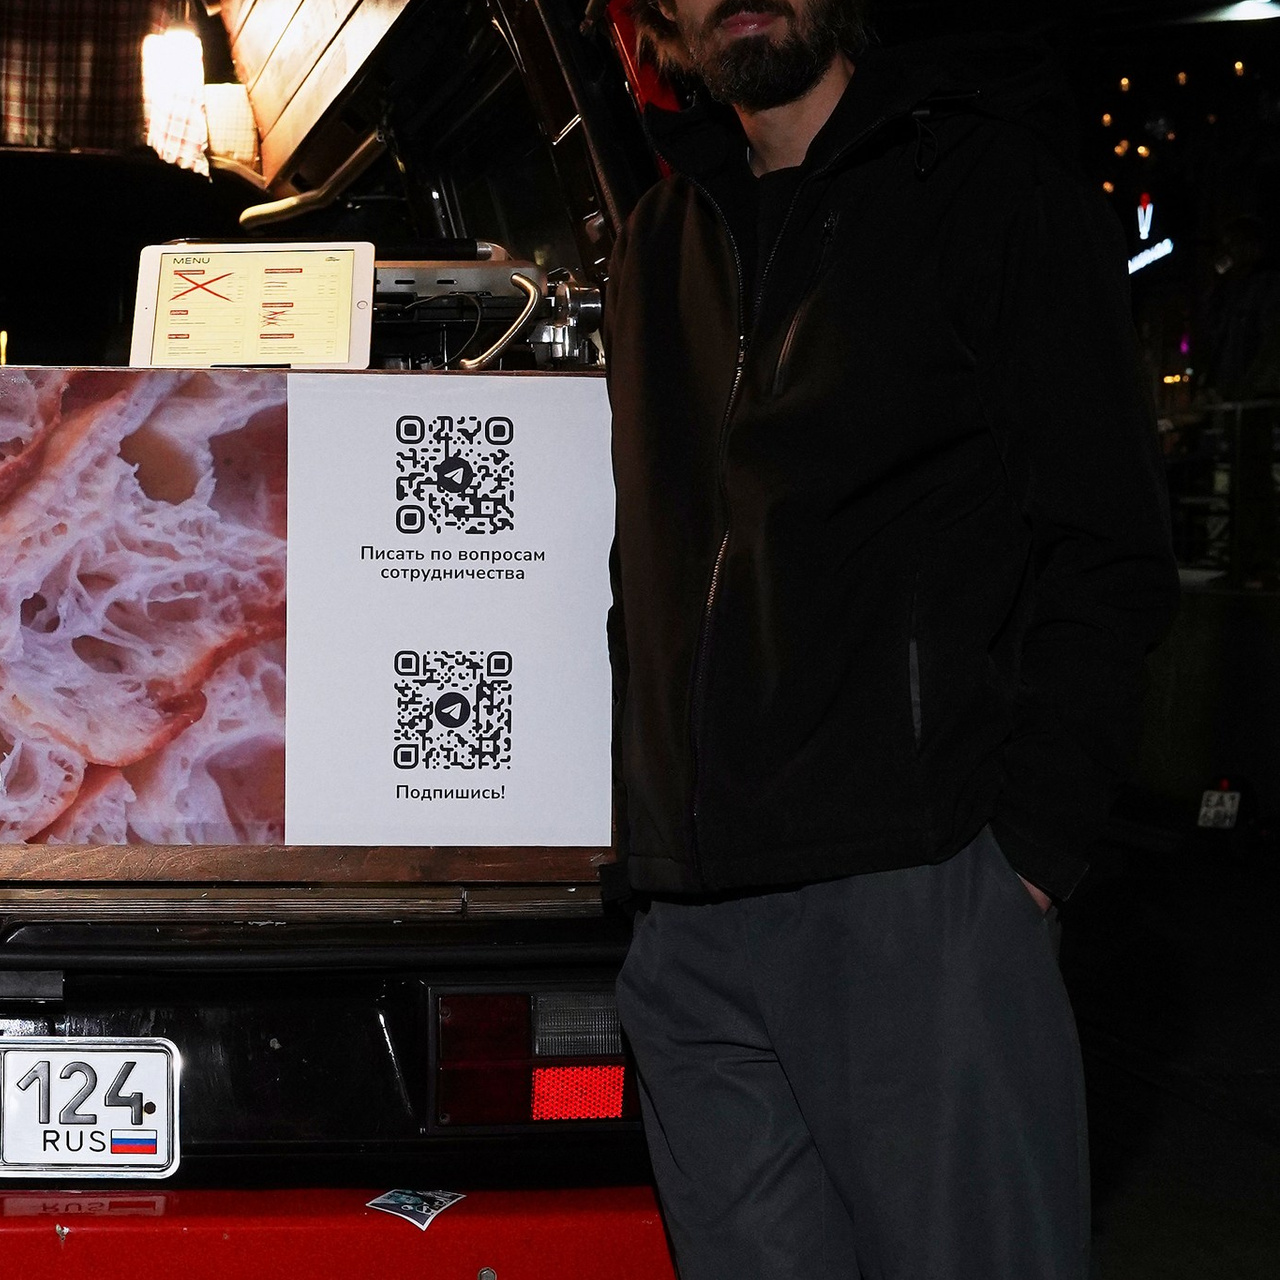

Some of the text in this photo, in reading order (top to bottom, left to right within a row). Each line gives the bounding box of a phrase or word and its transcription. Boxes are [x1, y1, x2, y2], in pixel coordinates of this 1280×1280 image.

[173, 257, 211, 265] MENU
[360, 545, 545, 564] Писать по вопросам
[380, 568, 525, 583] сотрудничества
[396, 784, 505, 802] Подпишись!
[16, 1060, 144, 1126] 124
[42, 1129, 107, 1153] RUS
